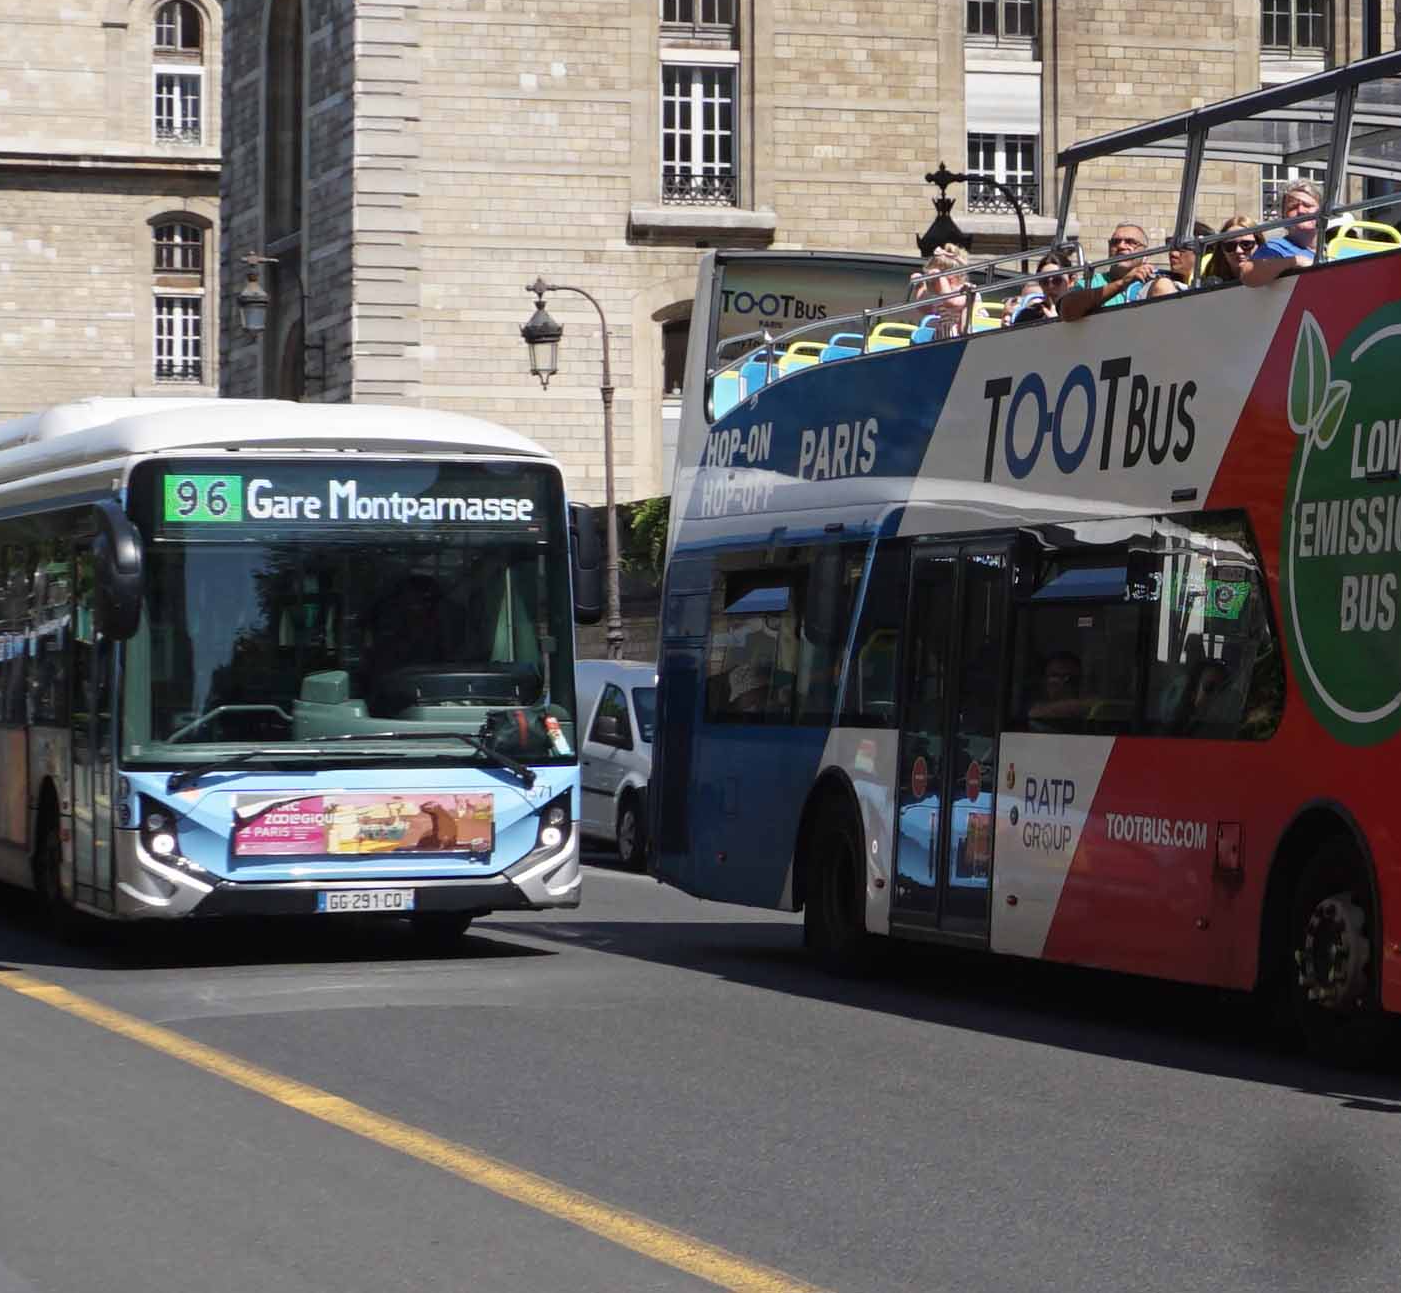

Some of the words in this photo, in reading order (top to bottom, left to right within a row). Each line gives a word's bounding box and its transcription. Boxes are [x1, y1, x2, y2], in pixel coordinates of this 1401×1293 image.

[706, 422, 773, 469] HOP-ON
[799, 417, 879, 481] PARIS
[175, 480, 229, 517] 96
[247, 478, 321, 520] Gare
[329, 479, 534, 524] Montparnasse
[1341, 573, 1398, 632] BUS
[1024, 777, 1075, 816] RATP
[254, 827, 290, 837] PARIS
[1023, 821, 1072, 853] GROUP
[1106, 813, 1208, 850] TOOTBUS.COM
